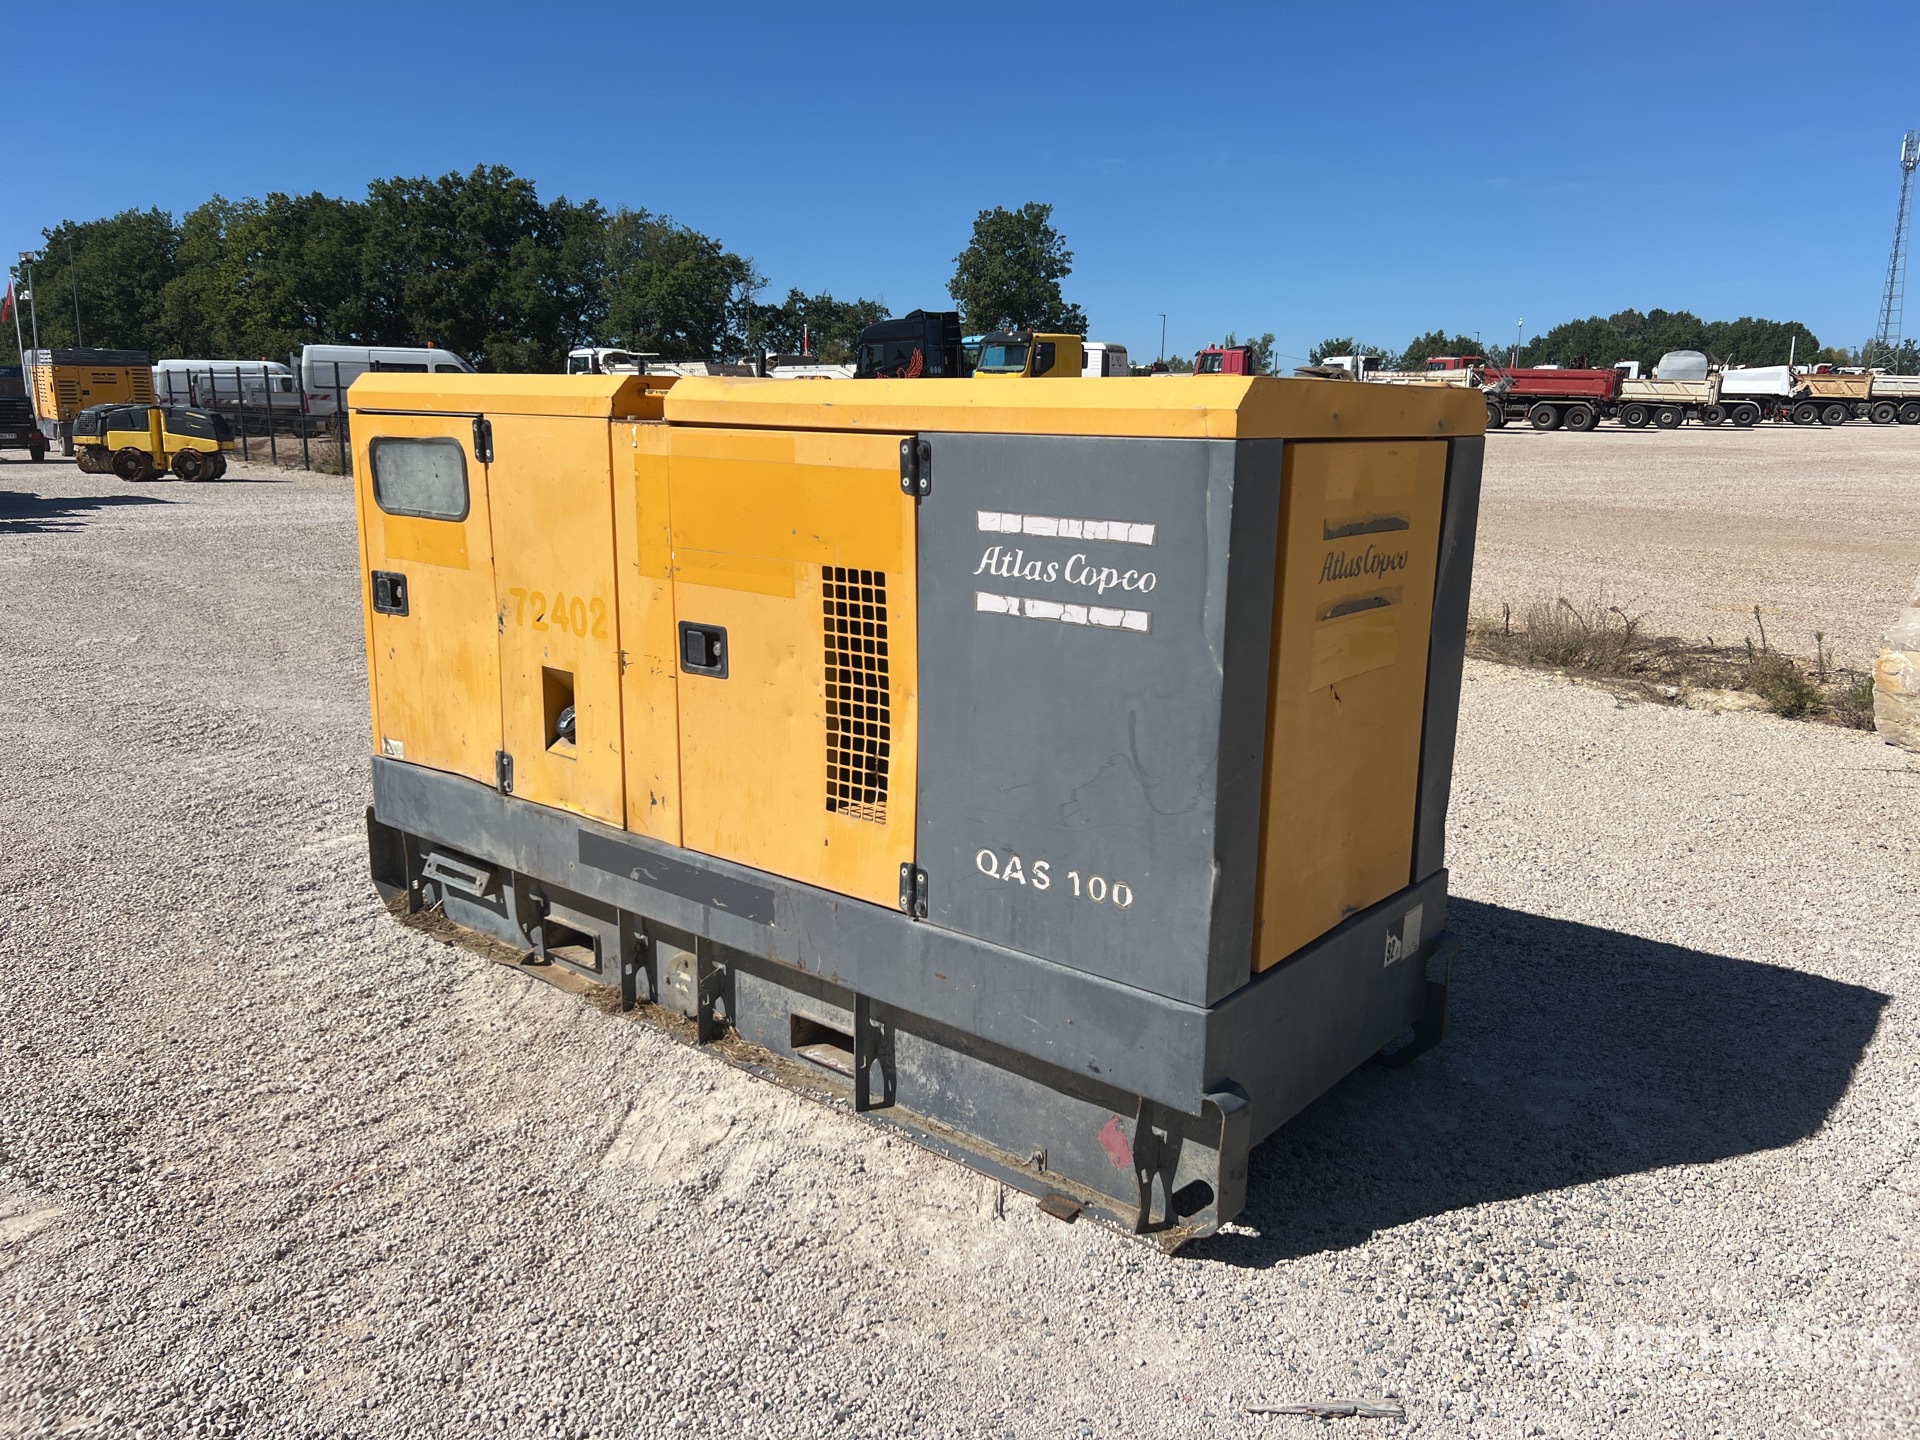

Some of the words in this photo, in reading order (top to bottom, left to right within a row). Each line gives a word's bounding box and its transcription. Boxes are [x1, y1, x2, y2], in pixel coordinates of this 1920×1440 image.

[973, 545, 1059, 583] Atlas
[1063, 553, 1157, 595] Copco
[1318, 550, 1363, 584] Atlas
[1363, 543, 1409, 580] Copco
[509, 587, 609, 640] 72402
[975, 848, 1052, 891] QAS
[1067, 869, 1134, 909] 100
